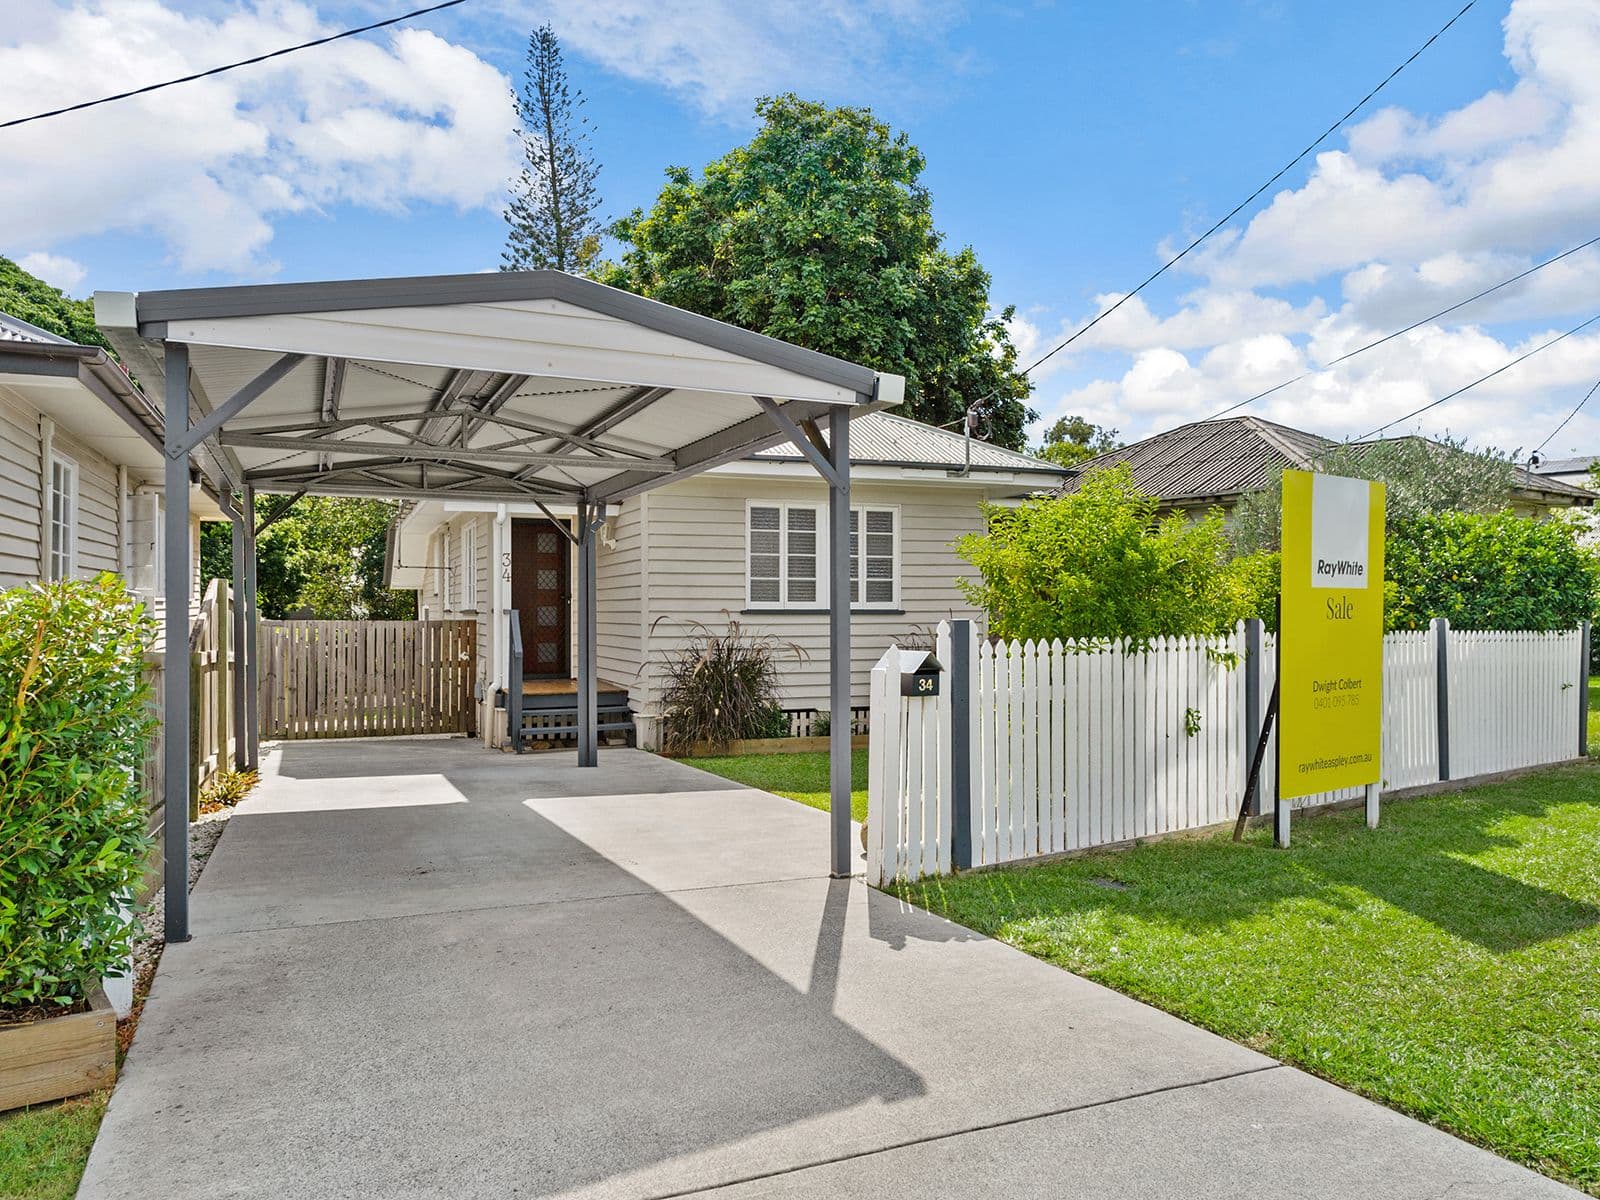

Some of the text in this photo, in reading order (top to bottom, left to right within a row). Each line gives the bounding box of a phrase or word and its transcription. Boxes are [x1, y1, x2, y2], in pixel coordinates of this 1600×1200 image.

[1317, 559, 1364, 577] RayWhite
[1326, 595, 1354, 620] Sale
[918, 678, 933, 691] 34
[1313, 678, 1362, 694] Dwight Colbert
[1298, 752, 1373, 775] raywhiteaspley.com.au
